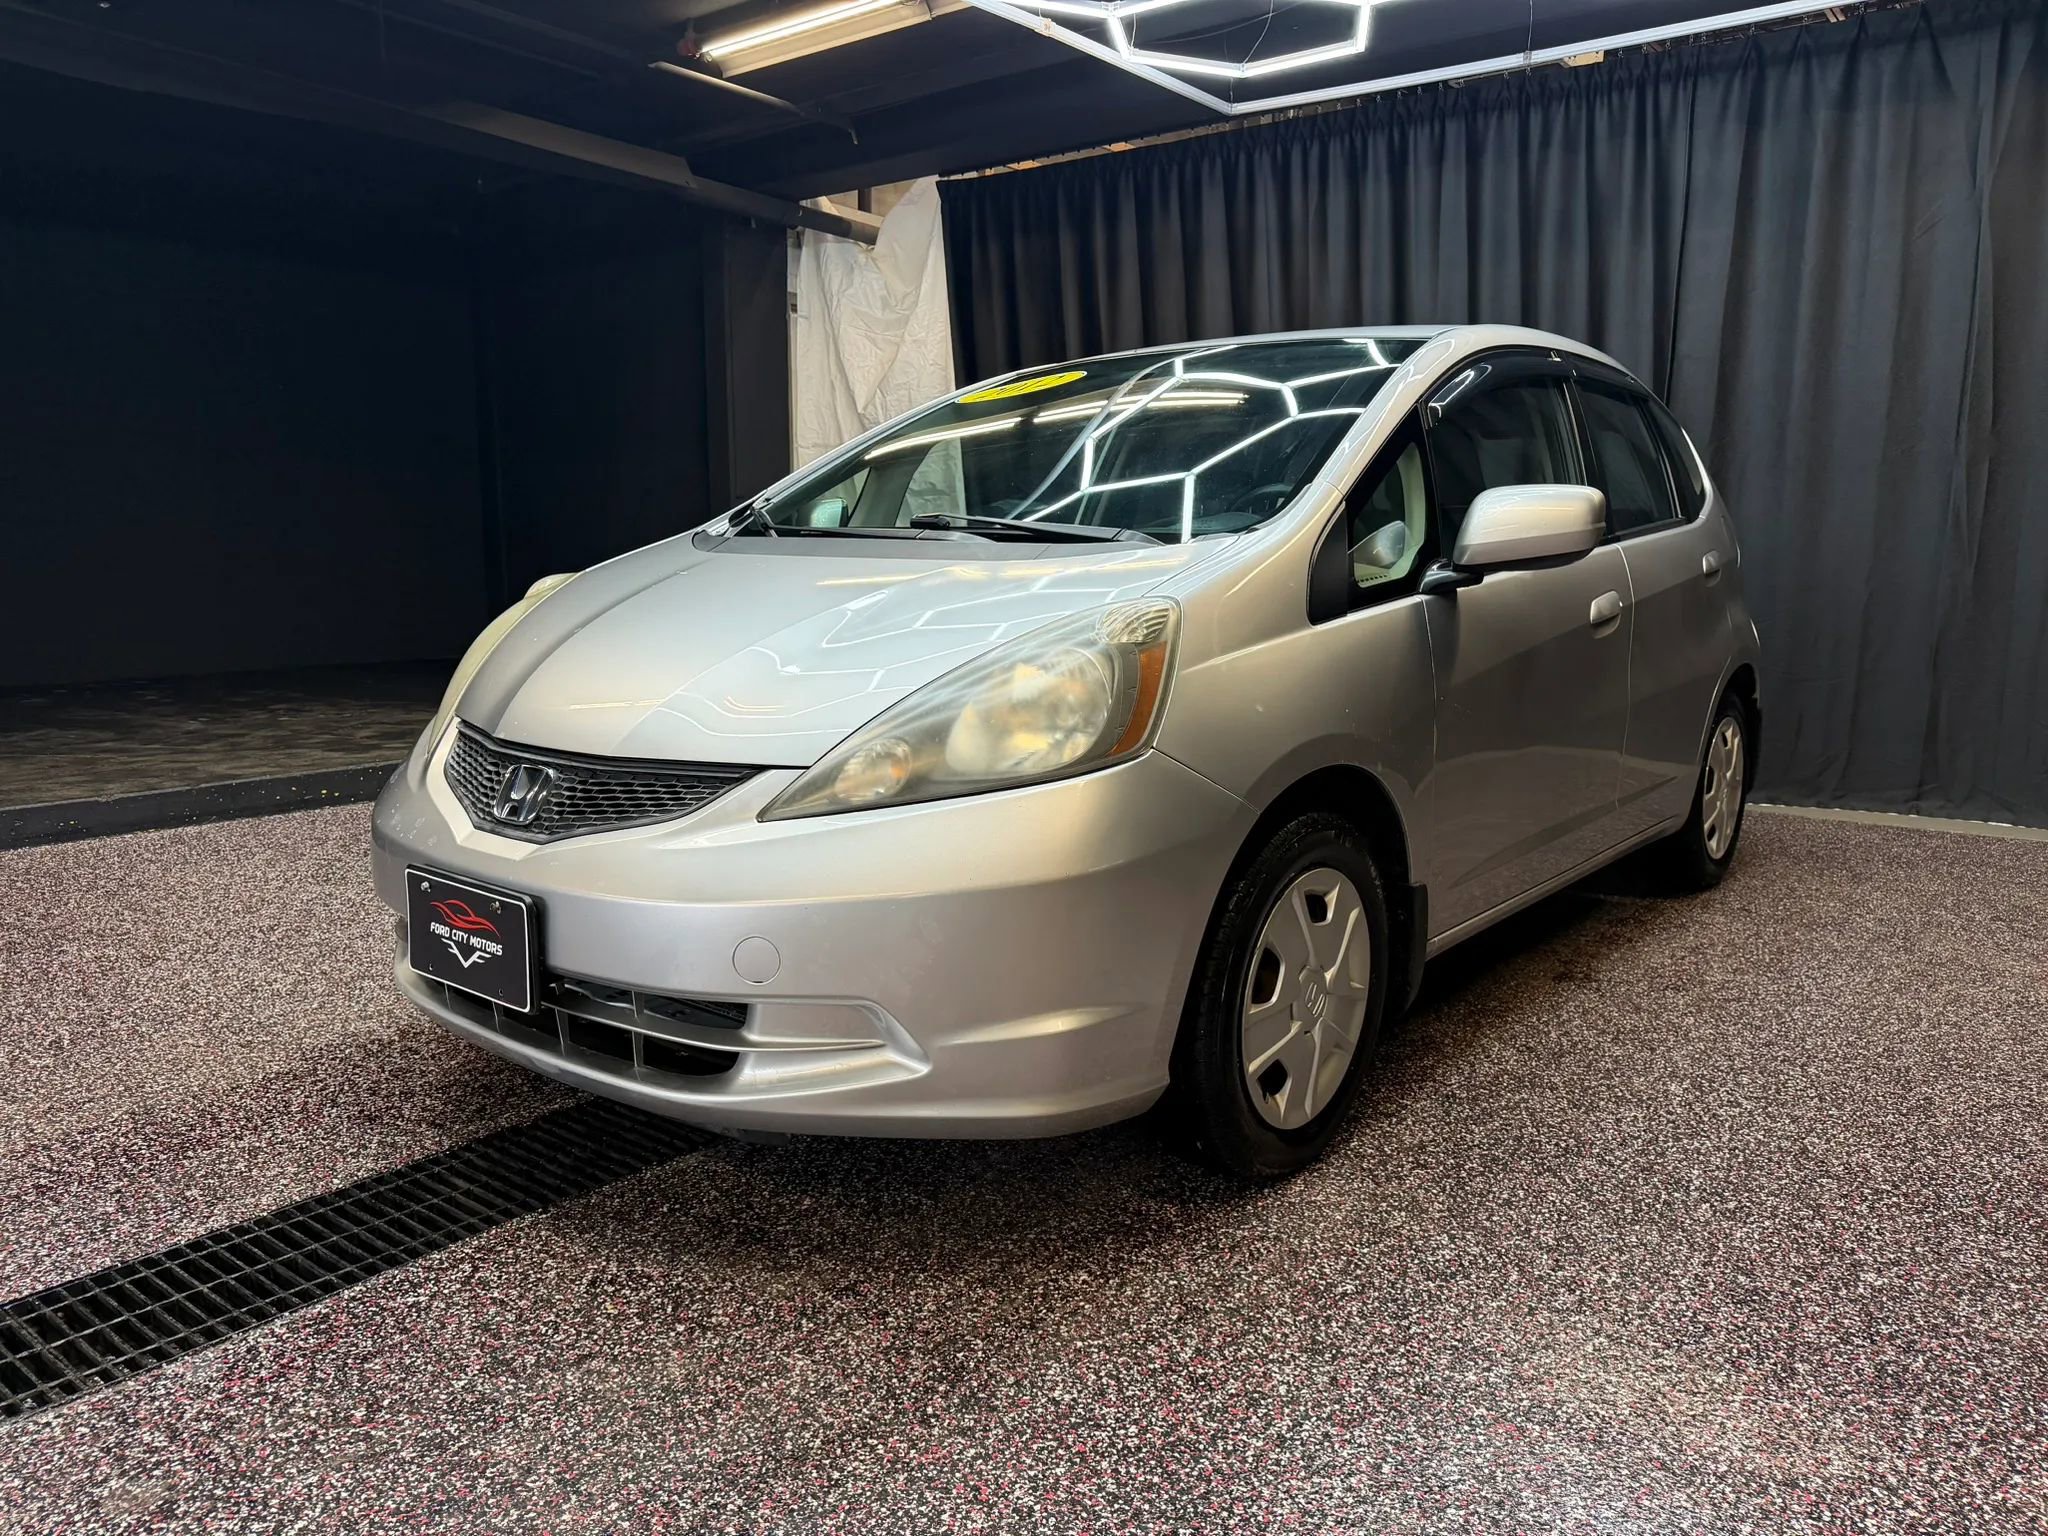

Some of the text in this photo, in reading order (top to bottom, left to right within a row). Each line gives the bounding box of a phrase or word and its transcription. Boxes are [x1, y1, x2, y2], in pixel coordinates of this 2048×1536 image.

[430, 922, 503, 956] FORD CITY MOTORS
